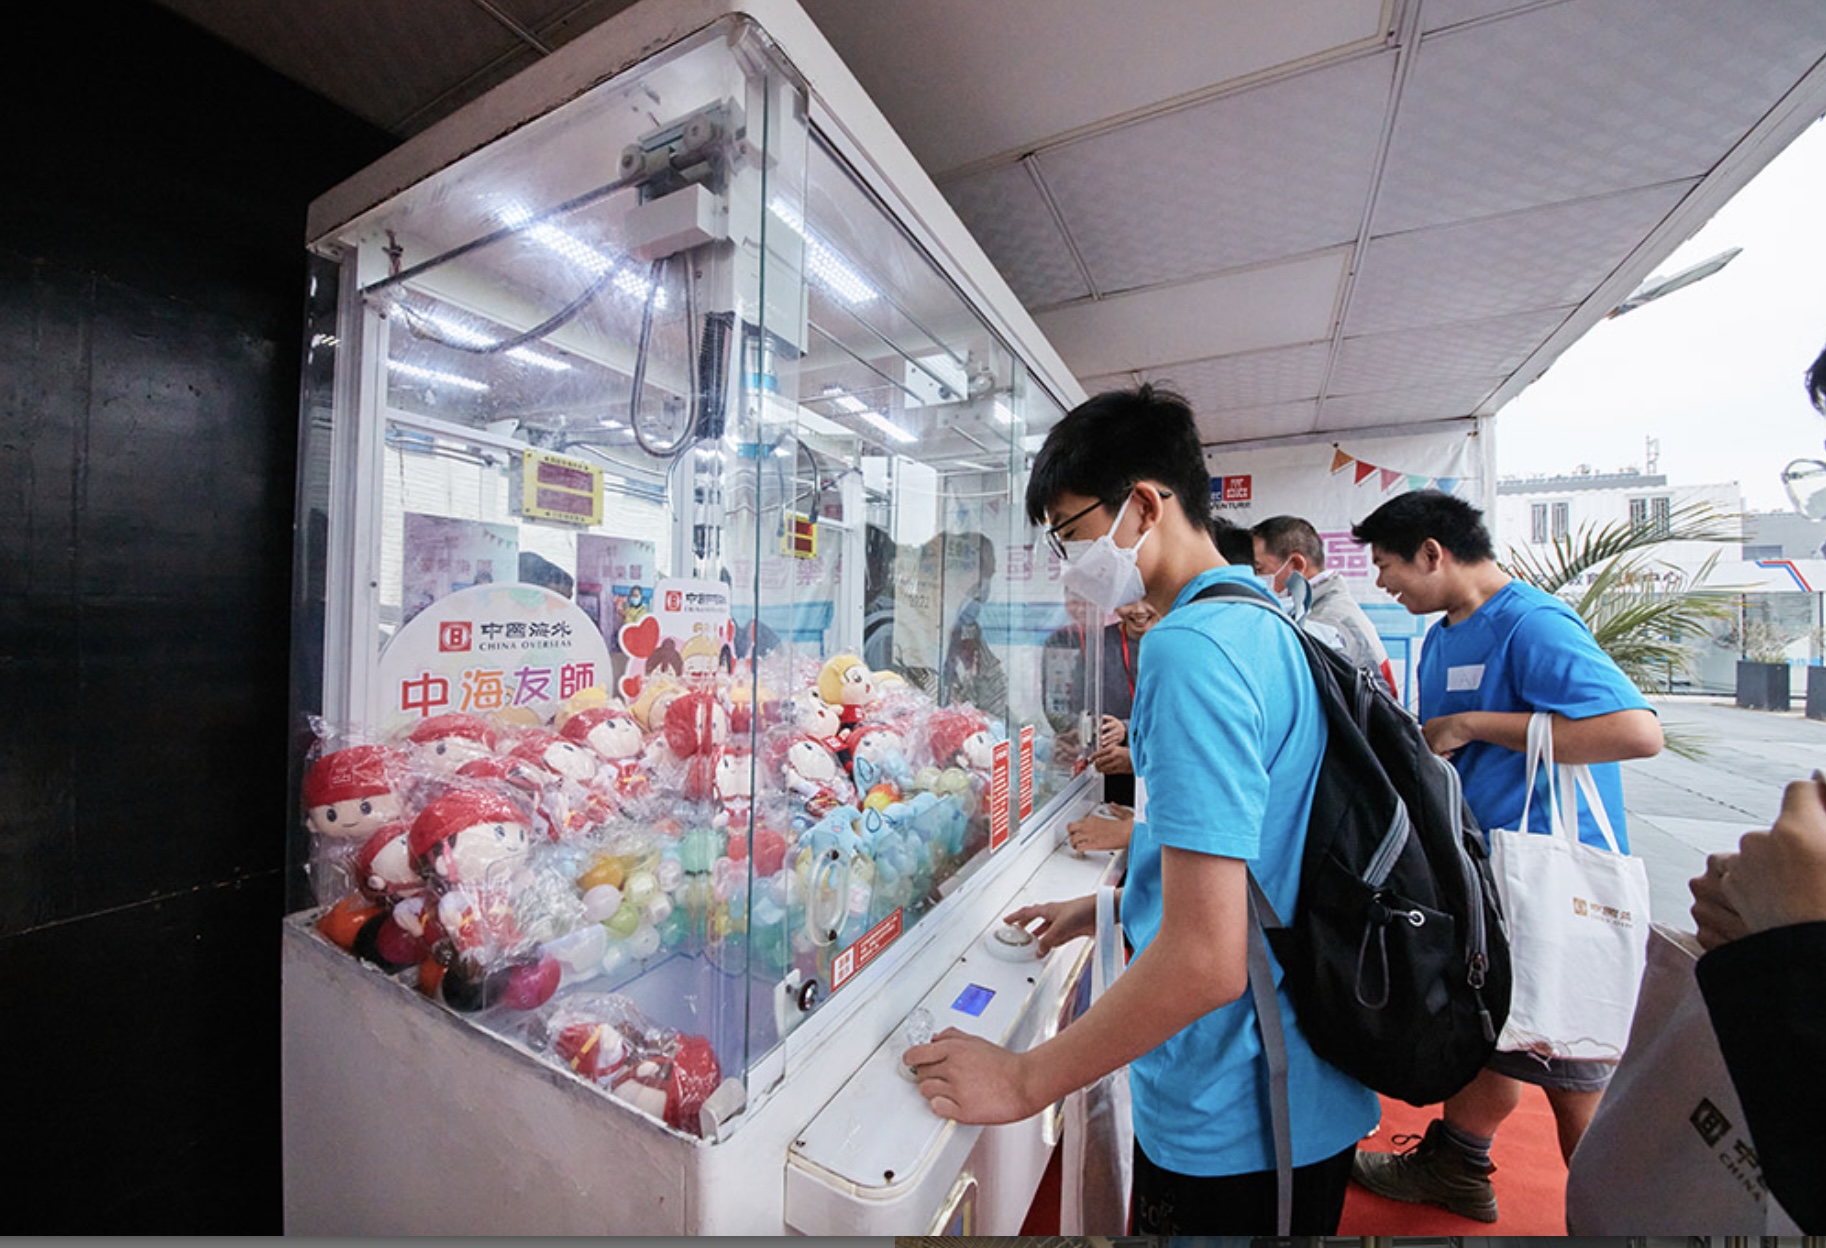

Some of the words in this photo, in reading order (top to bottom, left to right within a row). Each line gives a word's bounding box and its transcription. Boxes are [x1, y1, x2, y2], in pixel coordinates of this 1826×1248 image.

[479, 641, 517, 651] CHINA
[520, 640, 572, 650] OVERSEAS
[402, 662, 595, 717] 中海友師
[1719, 1153, 1761, 1202] CHINA
